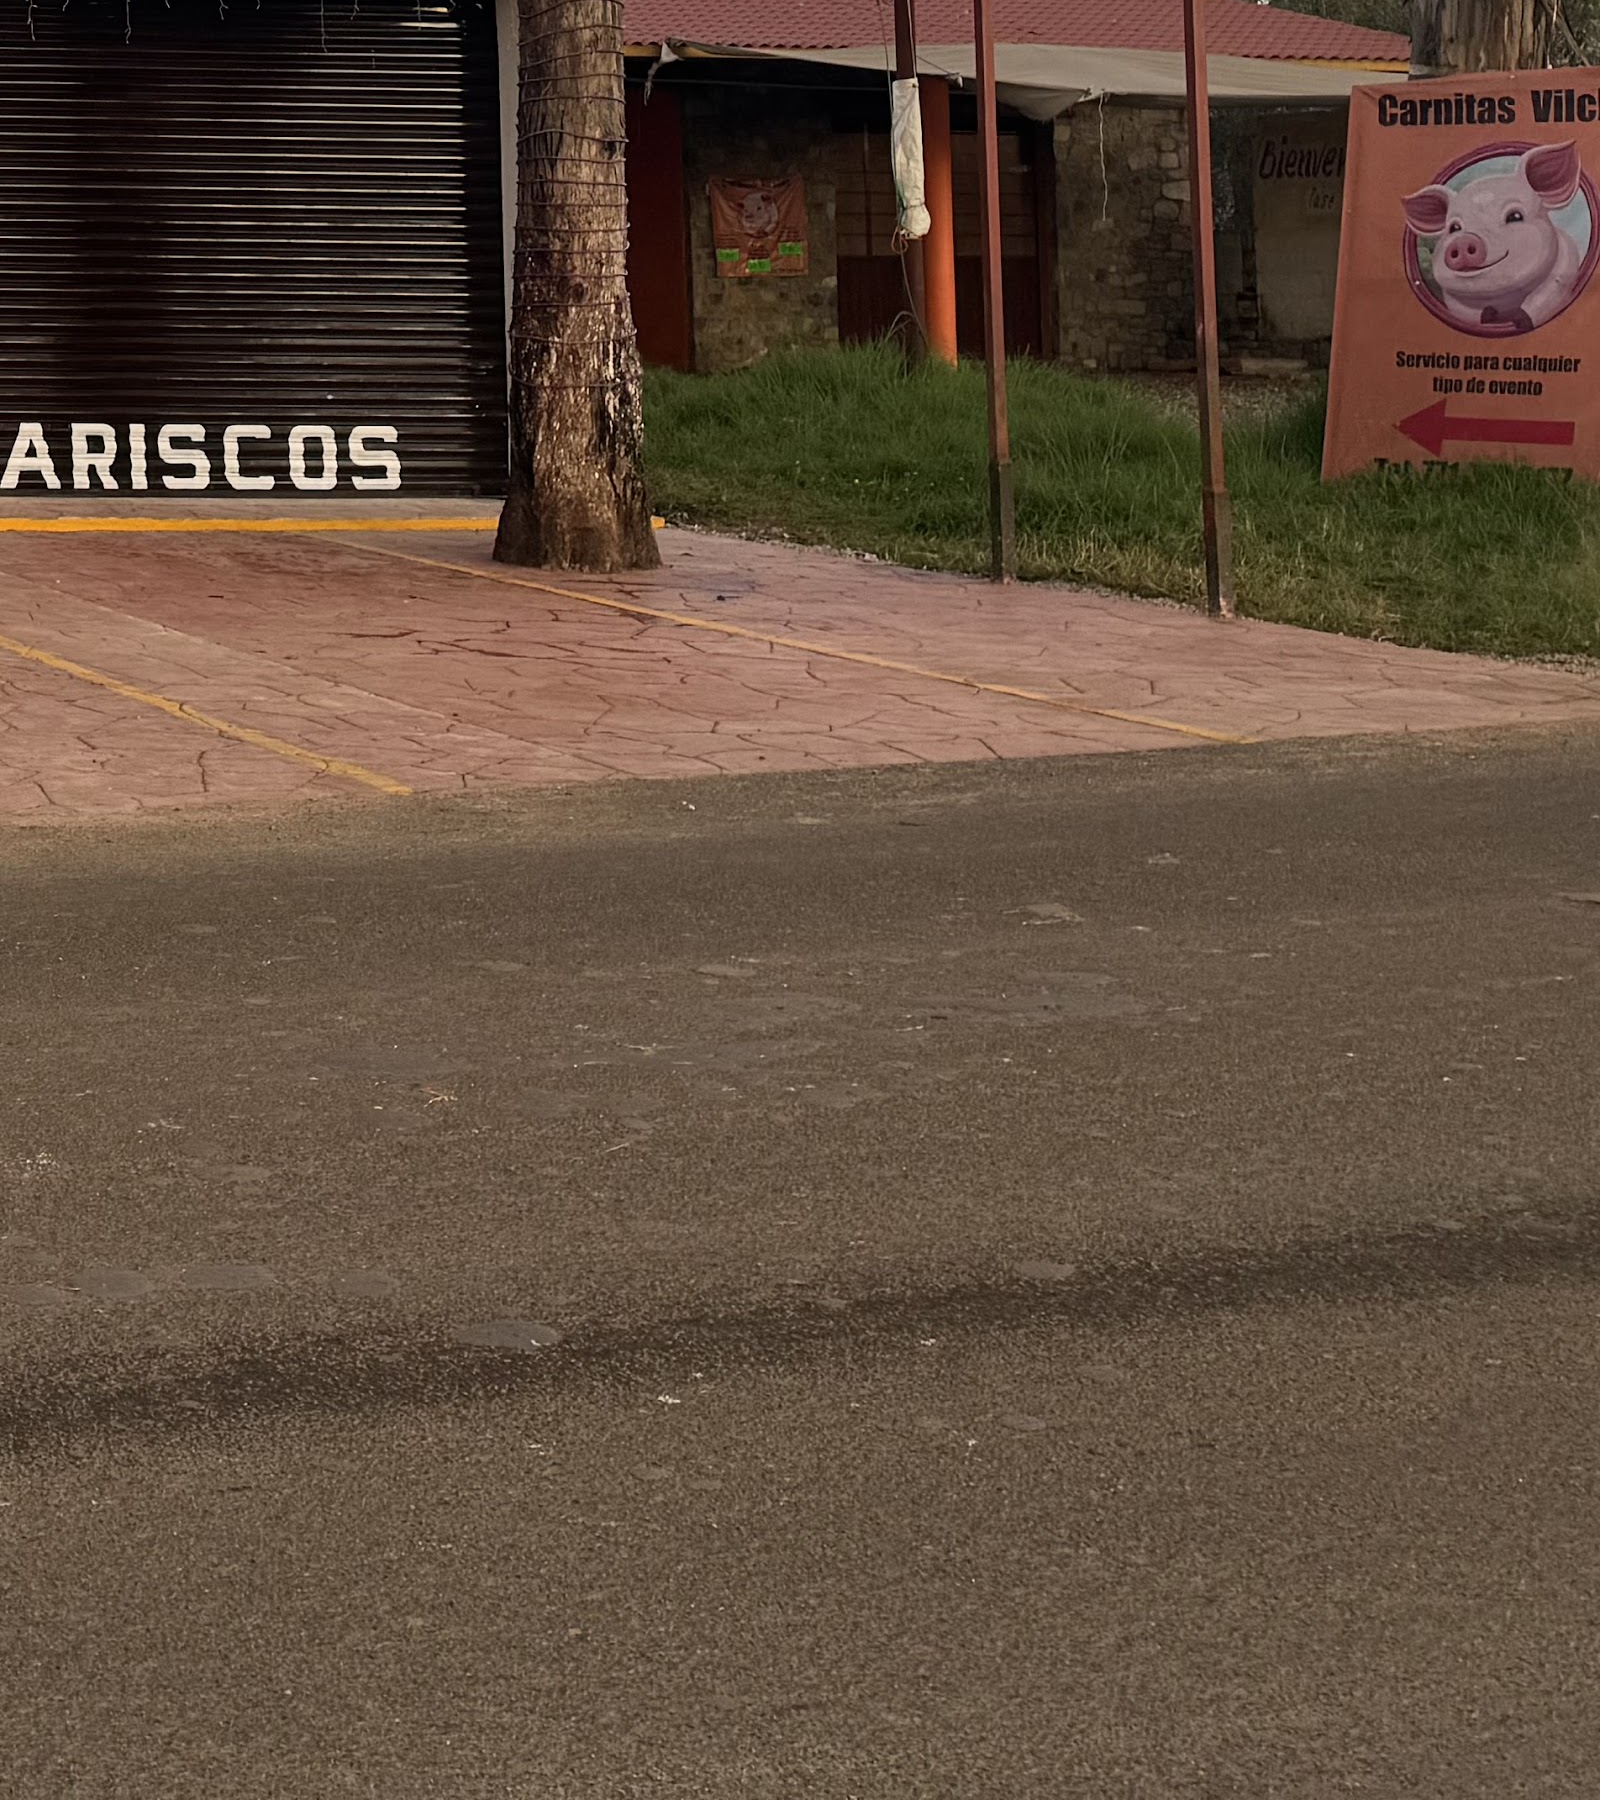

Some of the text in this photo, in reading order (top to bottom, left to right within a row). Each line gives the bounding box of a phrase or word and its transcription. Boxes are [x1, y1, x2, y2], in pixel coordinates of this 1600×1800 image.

[1378, 89, 1600, 126] Carnitas Vilc
[1396, 350, 1581, 373] Servicio para cualquier
[1432, 376, 1543, 396] tipo de evento
